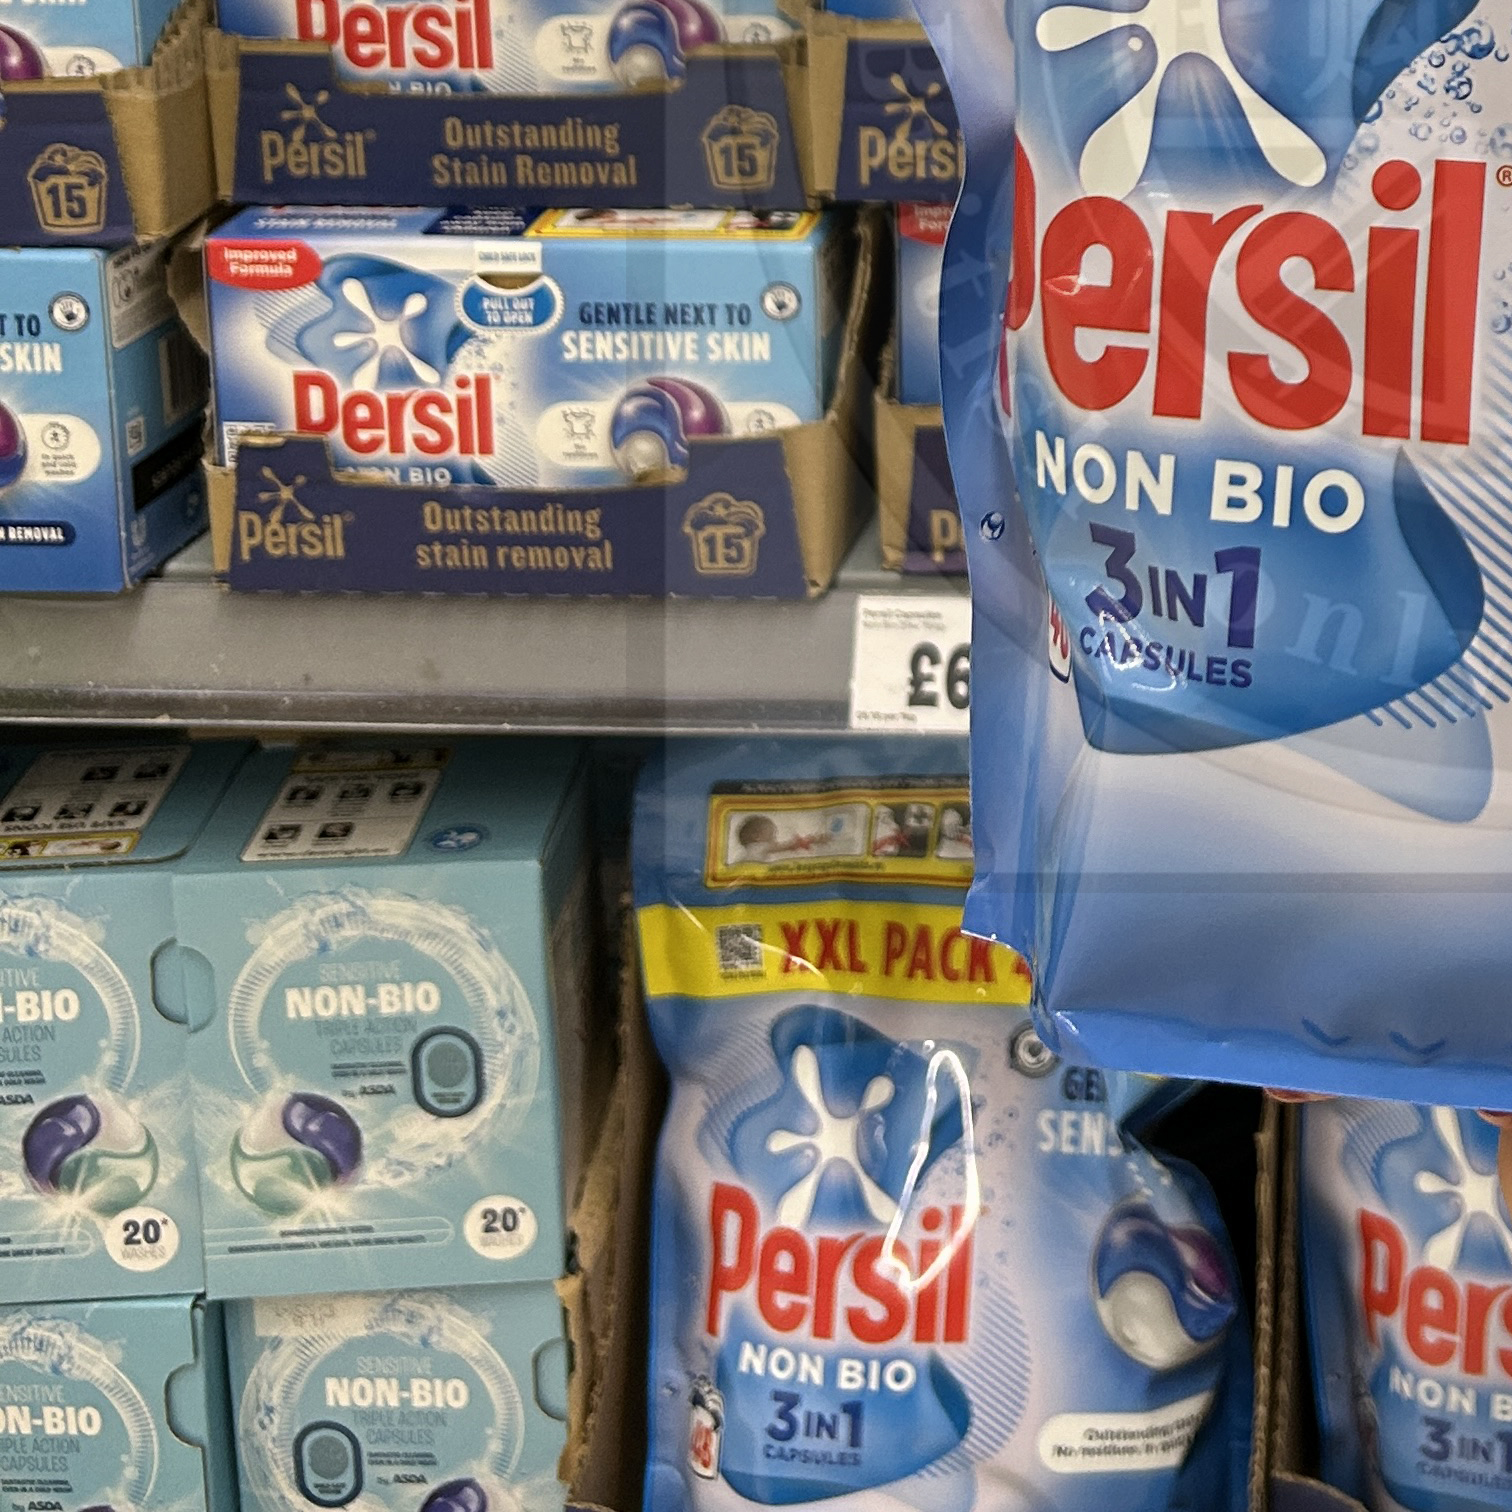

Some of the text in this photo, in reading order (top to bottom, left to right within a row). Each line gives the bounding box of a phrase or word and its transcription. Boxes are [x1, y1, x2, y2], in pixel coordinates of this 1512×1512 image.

[443, 116, 622, 155] Outstanding
[260, 129, 368, 182] Persil
[432, 154, 639, 186] Stain Removal
[719, 140, 759, 178] 15
[46, 183, 87, 220] 15
[223, 247, 298, 263] Improved
[230, 261, 293, 277] Formula
[14, 313, 41, 338] TO
[578, 302, 752, 326] GENTLE NEXT TO
[0, 342, 64, 374] SKIN
[561, 330, 771, 363] SENSITIVE SKIN
[1035, 429, 1366, 535] NON BIO
[8, 525, 66, 542] REMOVAL
[237, 511, 347, 562] Persil
[422, 500, 603, 540] Outstanding
[416, 538, 614, 571] stain removal
[704, 537, 745, 566] 15
[1078, 625, 1253, 688] CAPSULES
[779, 918, 997, 984] XXL PACK
[0, 988, 81, 1023] -BIO
[284, 981, 442, 1019] NON-BIO
[2, 1024, 56, 1043] ACTION
[706, 1182, 975, 1345] Persil
[738, 1341, 917, 1392] NON BIO
[324, 1376, 470, 1410] NON-BIO
[1389, 1367, 1477, 1418] NON
[0, 1405, 103, 1437] ON-BIO
[31, 1438, 81, 1455] ACTION
[762, 1443, 862, 1467] CAPSULES
[1, 1456, 70, 1474] CAPSULES
[28, 1500, 64, 1512] ASDA
